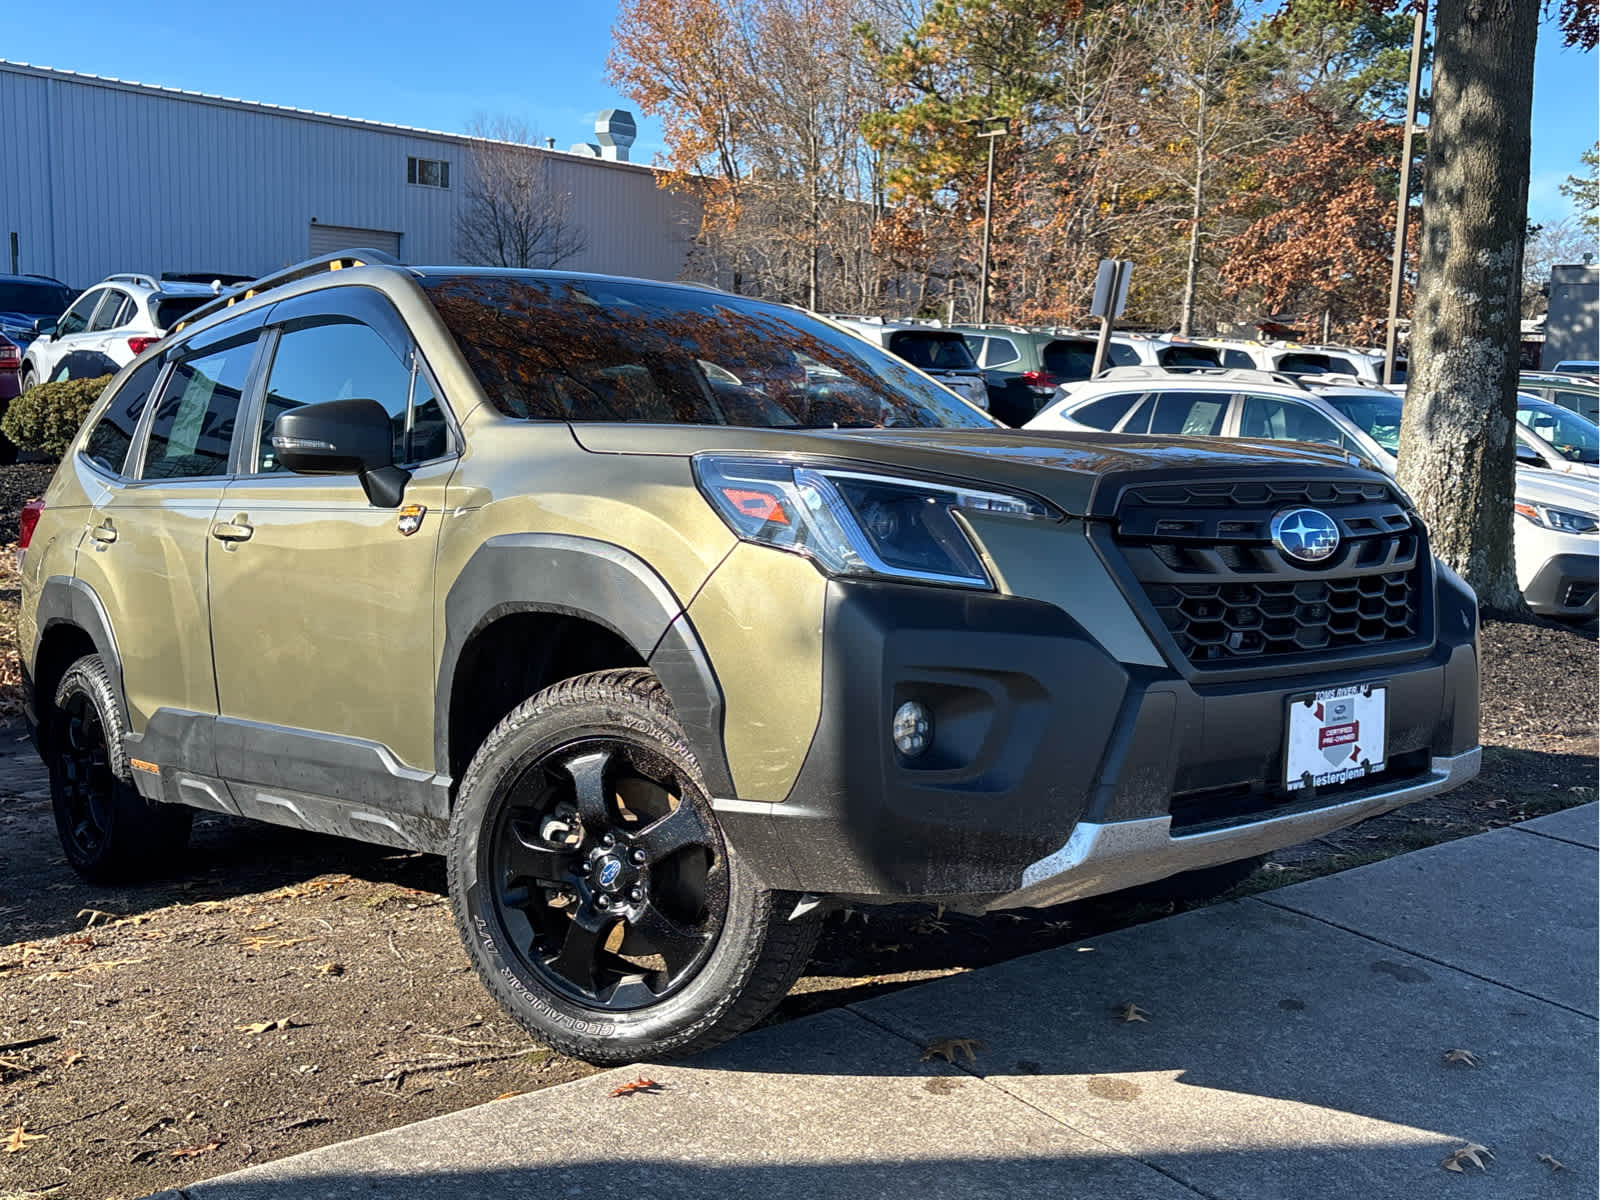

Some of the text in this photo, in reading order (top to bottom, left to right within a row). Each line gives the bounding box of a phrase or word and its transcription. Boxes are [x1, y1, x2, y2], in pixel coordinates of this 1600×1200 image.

[1315, 689, 1336, 701] TOMS
[1325, 726, 1353, 737] CERTIFIED
[1322, 733, 1356, 745] PRE-OWNED
[1313, 767, 1365, 787] lesterglenn
[500, 966, 616, 1037] GEOLANDAR
